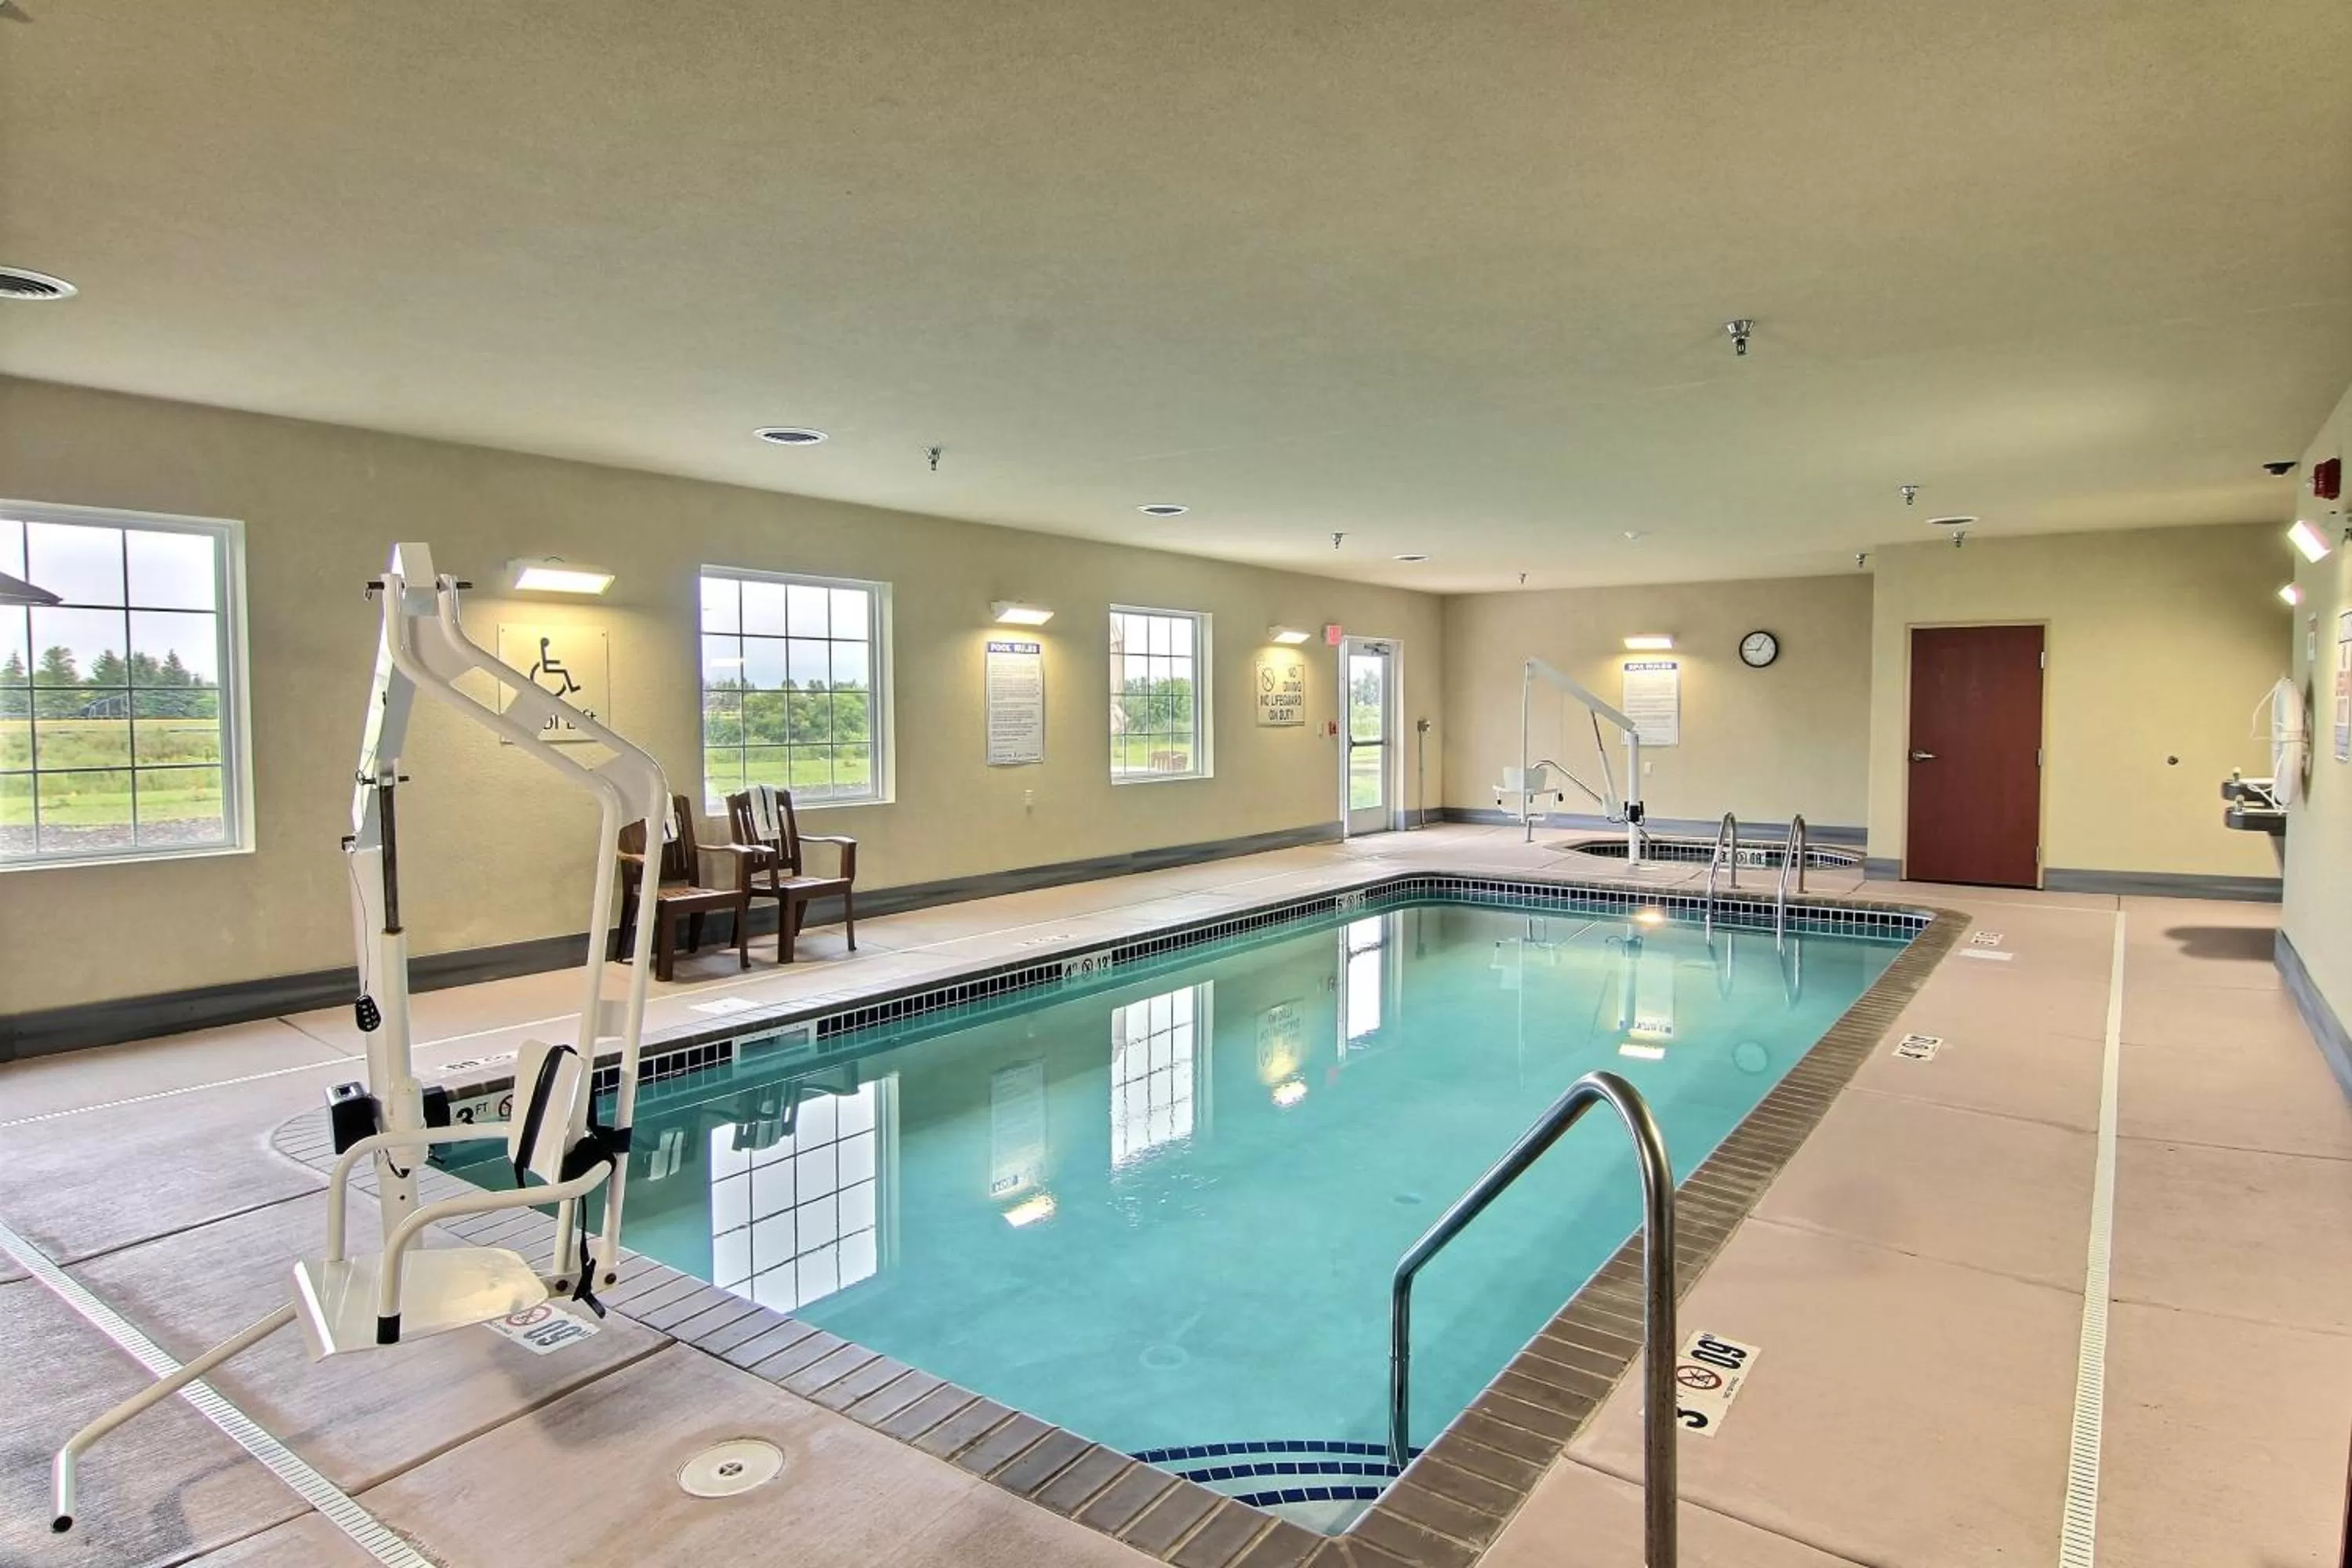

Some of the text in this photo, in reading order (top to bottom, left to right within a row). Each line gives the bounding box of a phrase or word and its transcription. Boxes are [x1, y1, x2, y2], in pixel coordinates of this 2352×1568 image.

[990, 643, 1037, 653] POOL RULES
[1260, 694, 1301, 706] NO LIFEGUARD
[1269, 709, 1278, 720] ON
[456, 1102, 488, 1124] 3 FT
